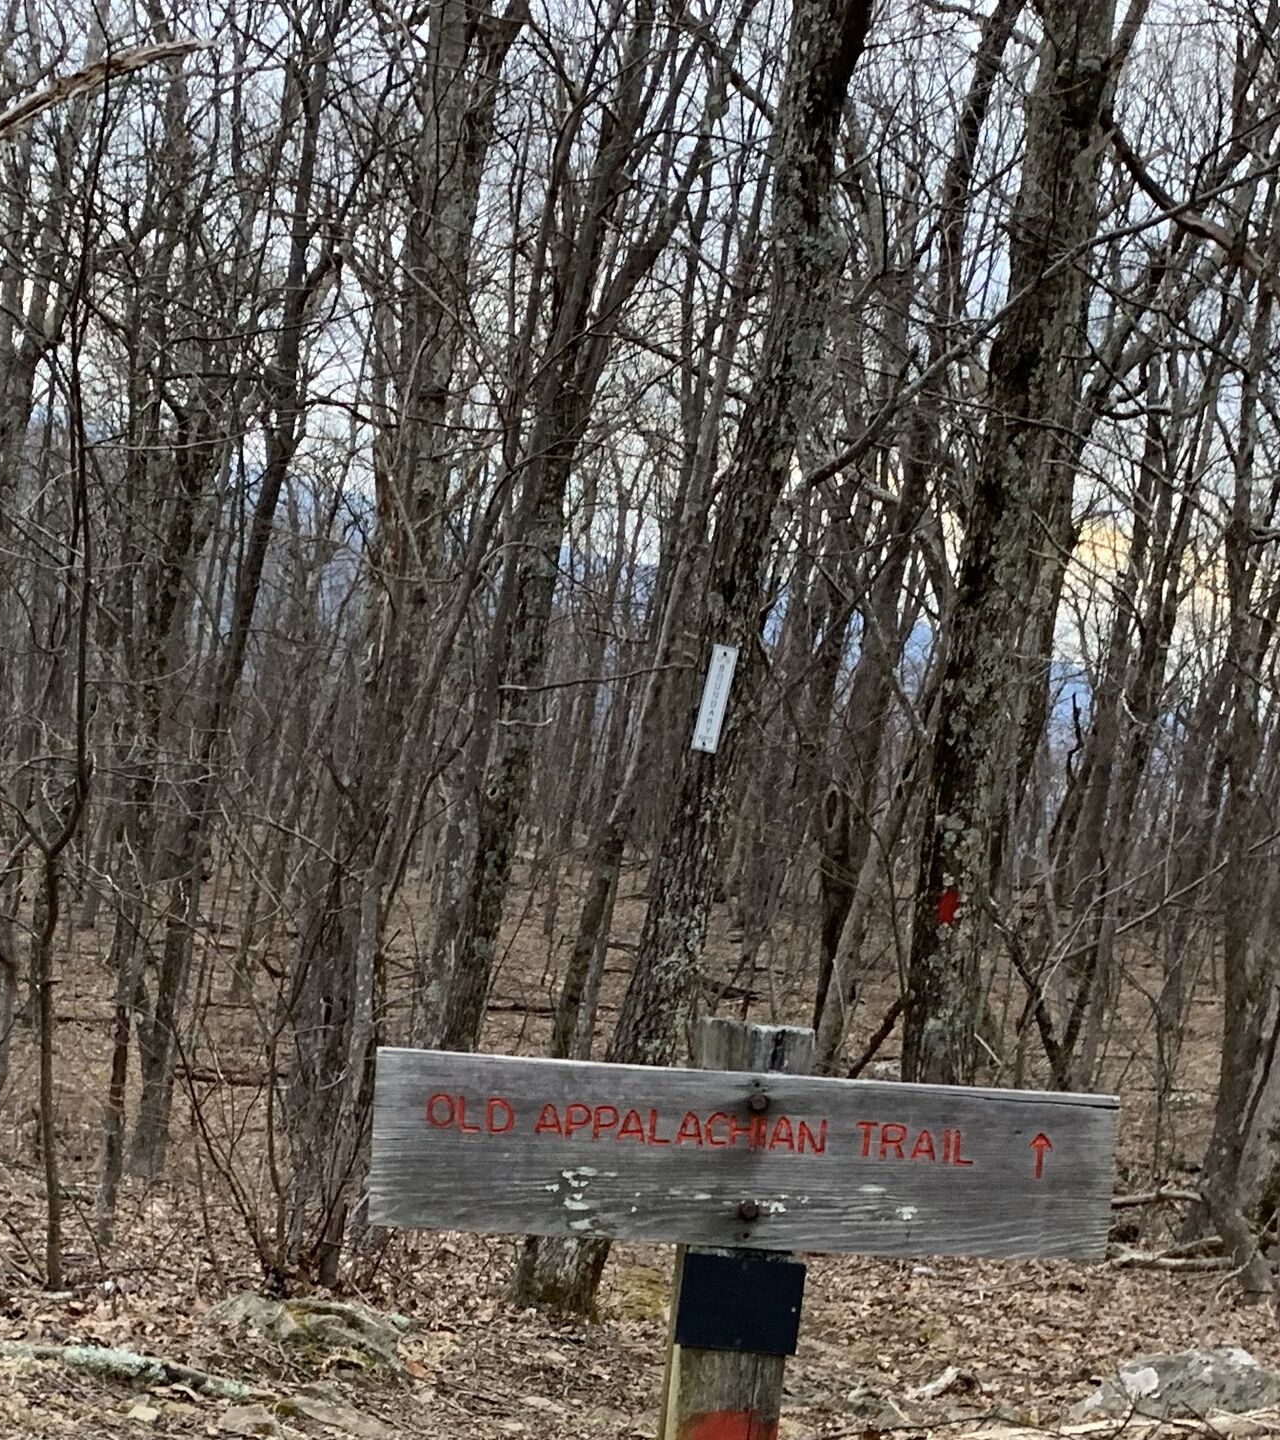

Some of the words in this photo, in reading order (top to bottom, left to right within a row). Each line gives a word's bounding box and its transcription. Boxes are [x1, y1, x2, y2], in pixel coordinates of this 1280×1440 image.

[705, 664, 725, 734] BOUNDARY
[425, 1092, 515, 1135] OLD
[533, 1103, 828, 1155] APPALACHIAN
[856, 1120, 973, 1168] TRAIL
